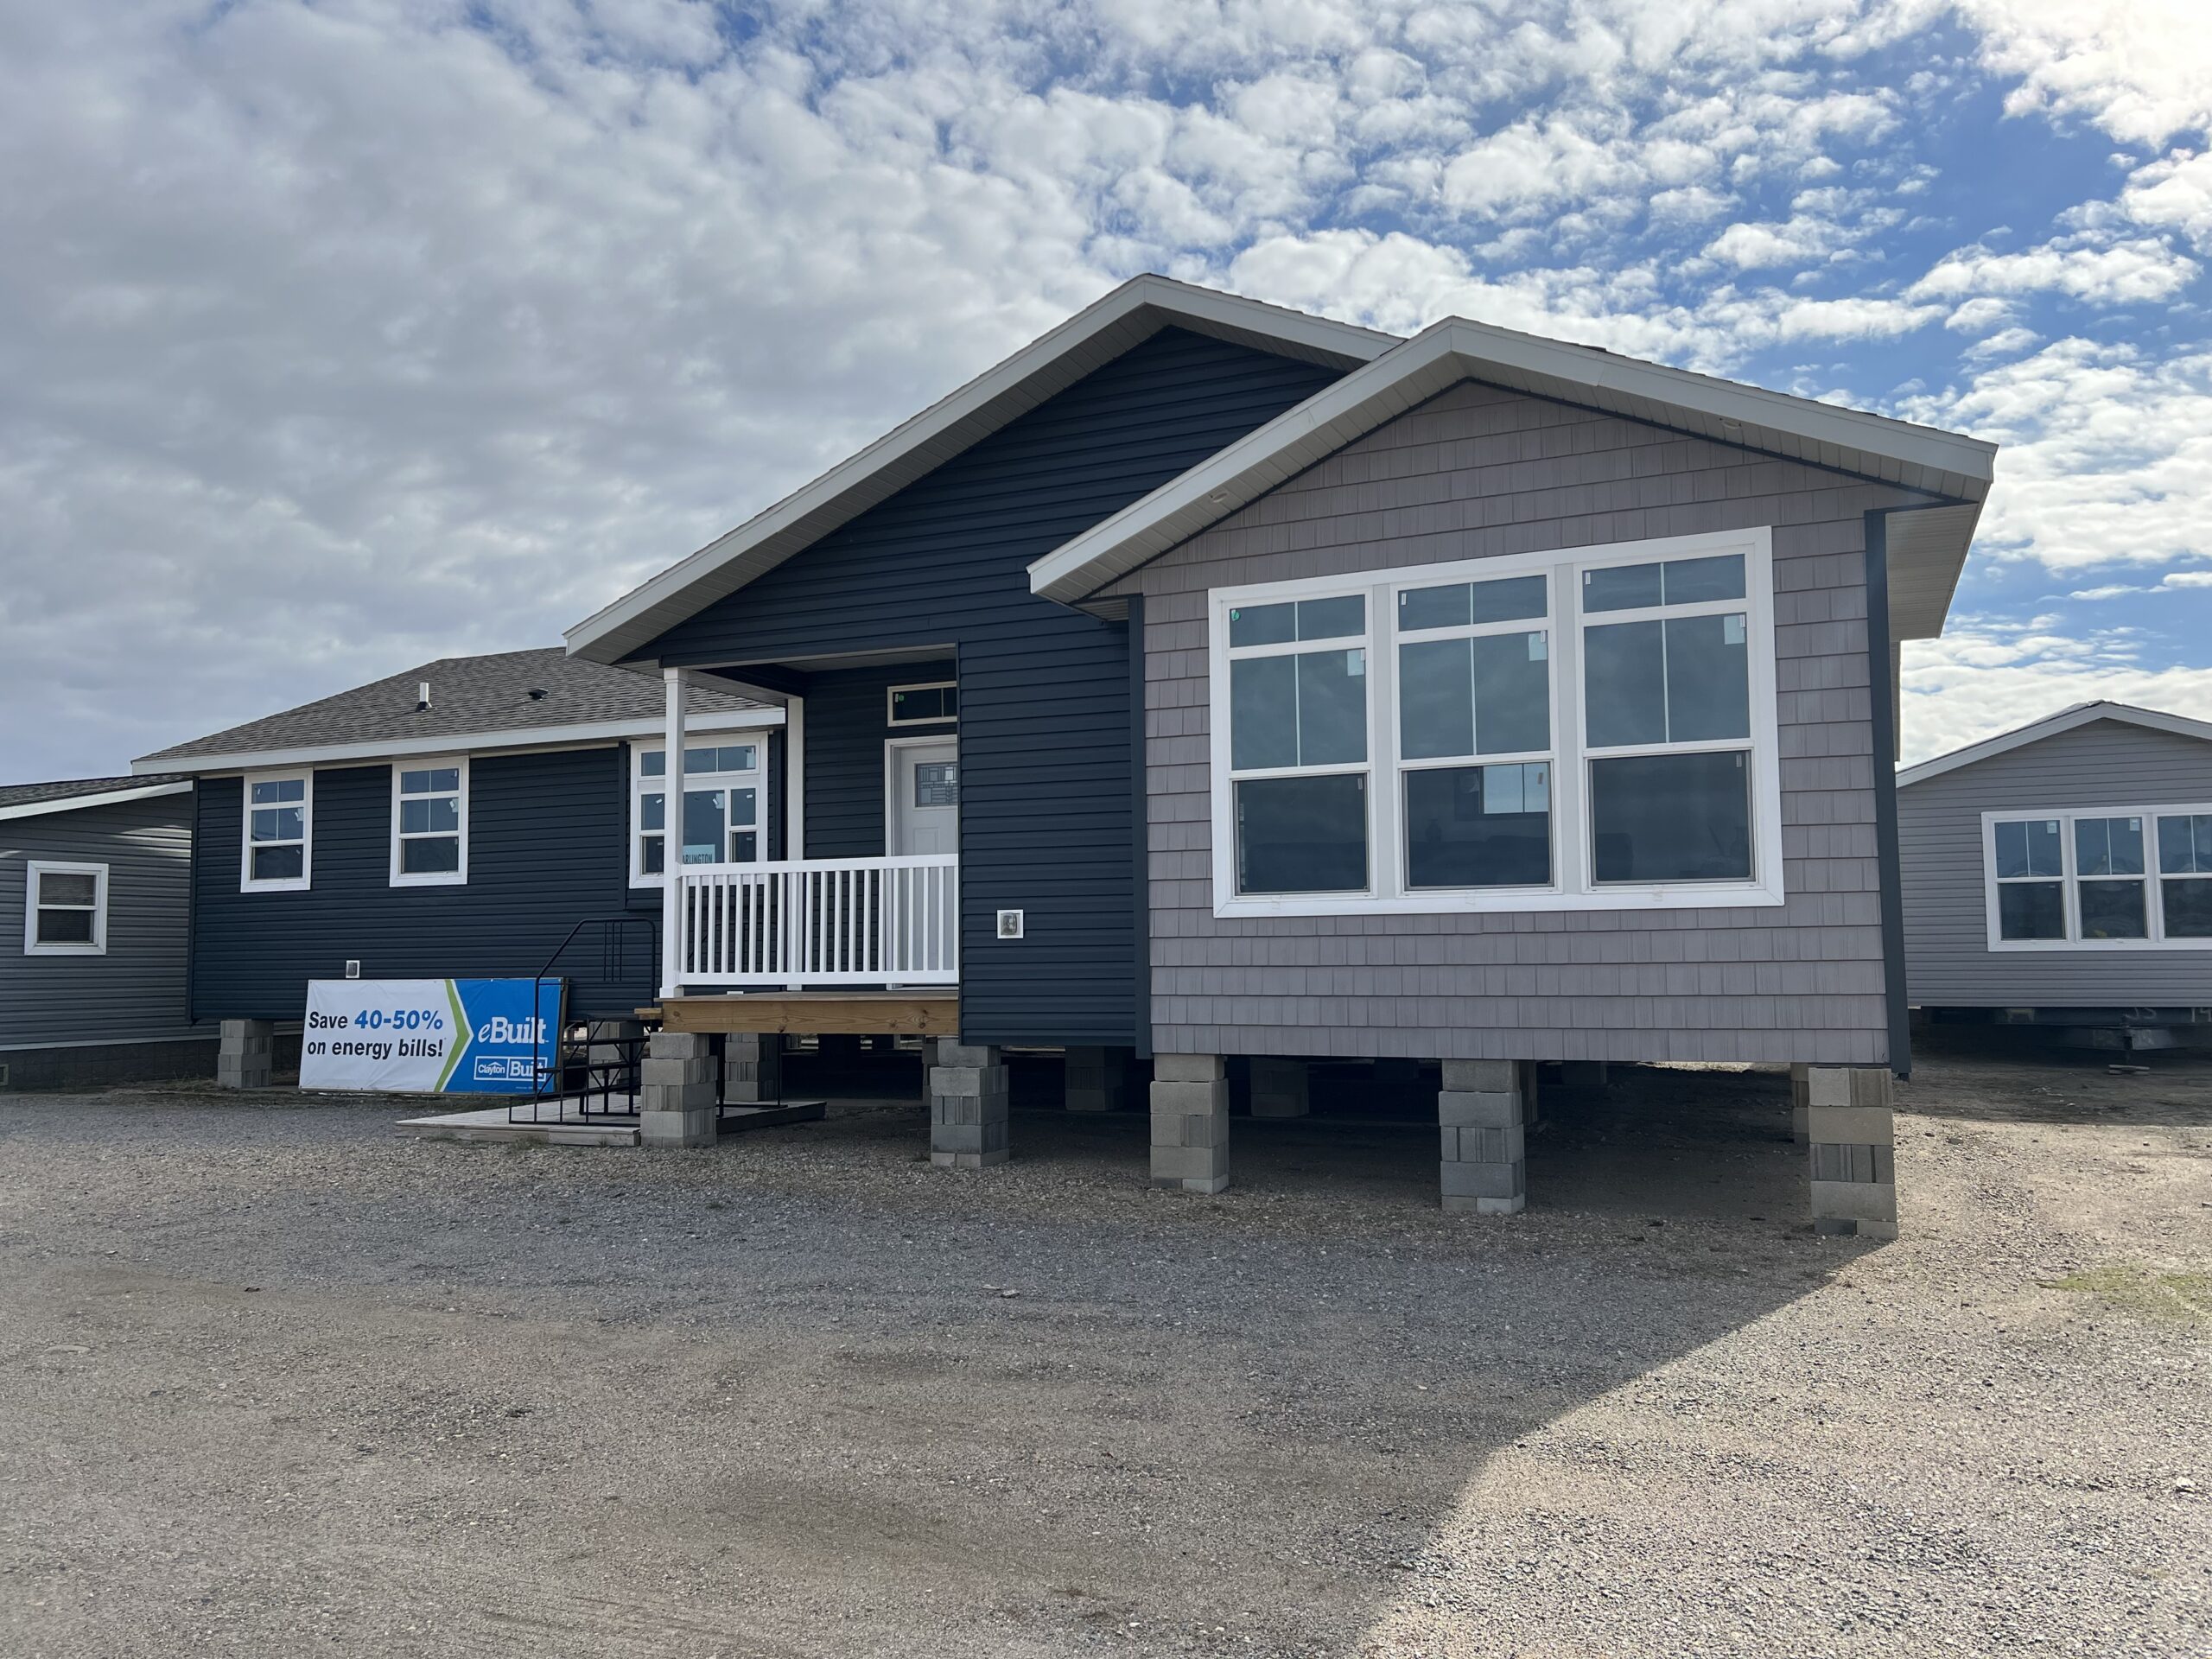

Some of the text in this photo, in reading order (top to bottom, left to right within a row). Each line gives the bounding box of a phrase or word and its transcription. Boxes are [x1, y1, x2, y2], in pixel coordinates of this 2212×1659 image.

[308, 1009, 443, 1030] Save 40-50%
[478, 1016, 546, 1044] eBuilt
[308, 1039, 443, 1060] on energy bills!
[478, 1064, 505, 1076] Clayton
[510, 1060, 543, 1077] Buit
